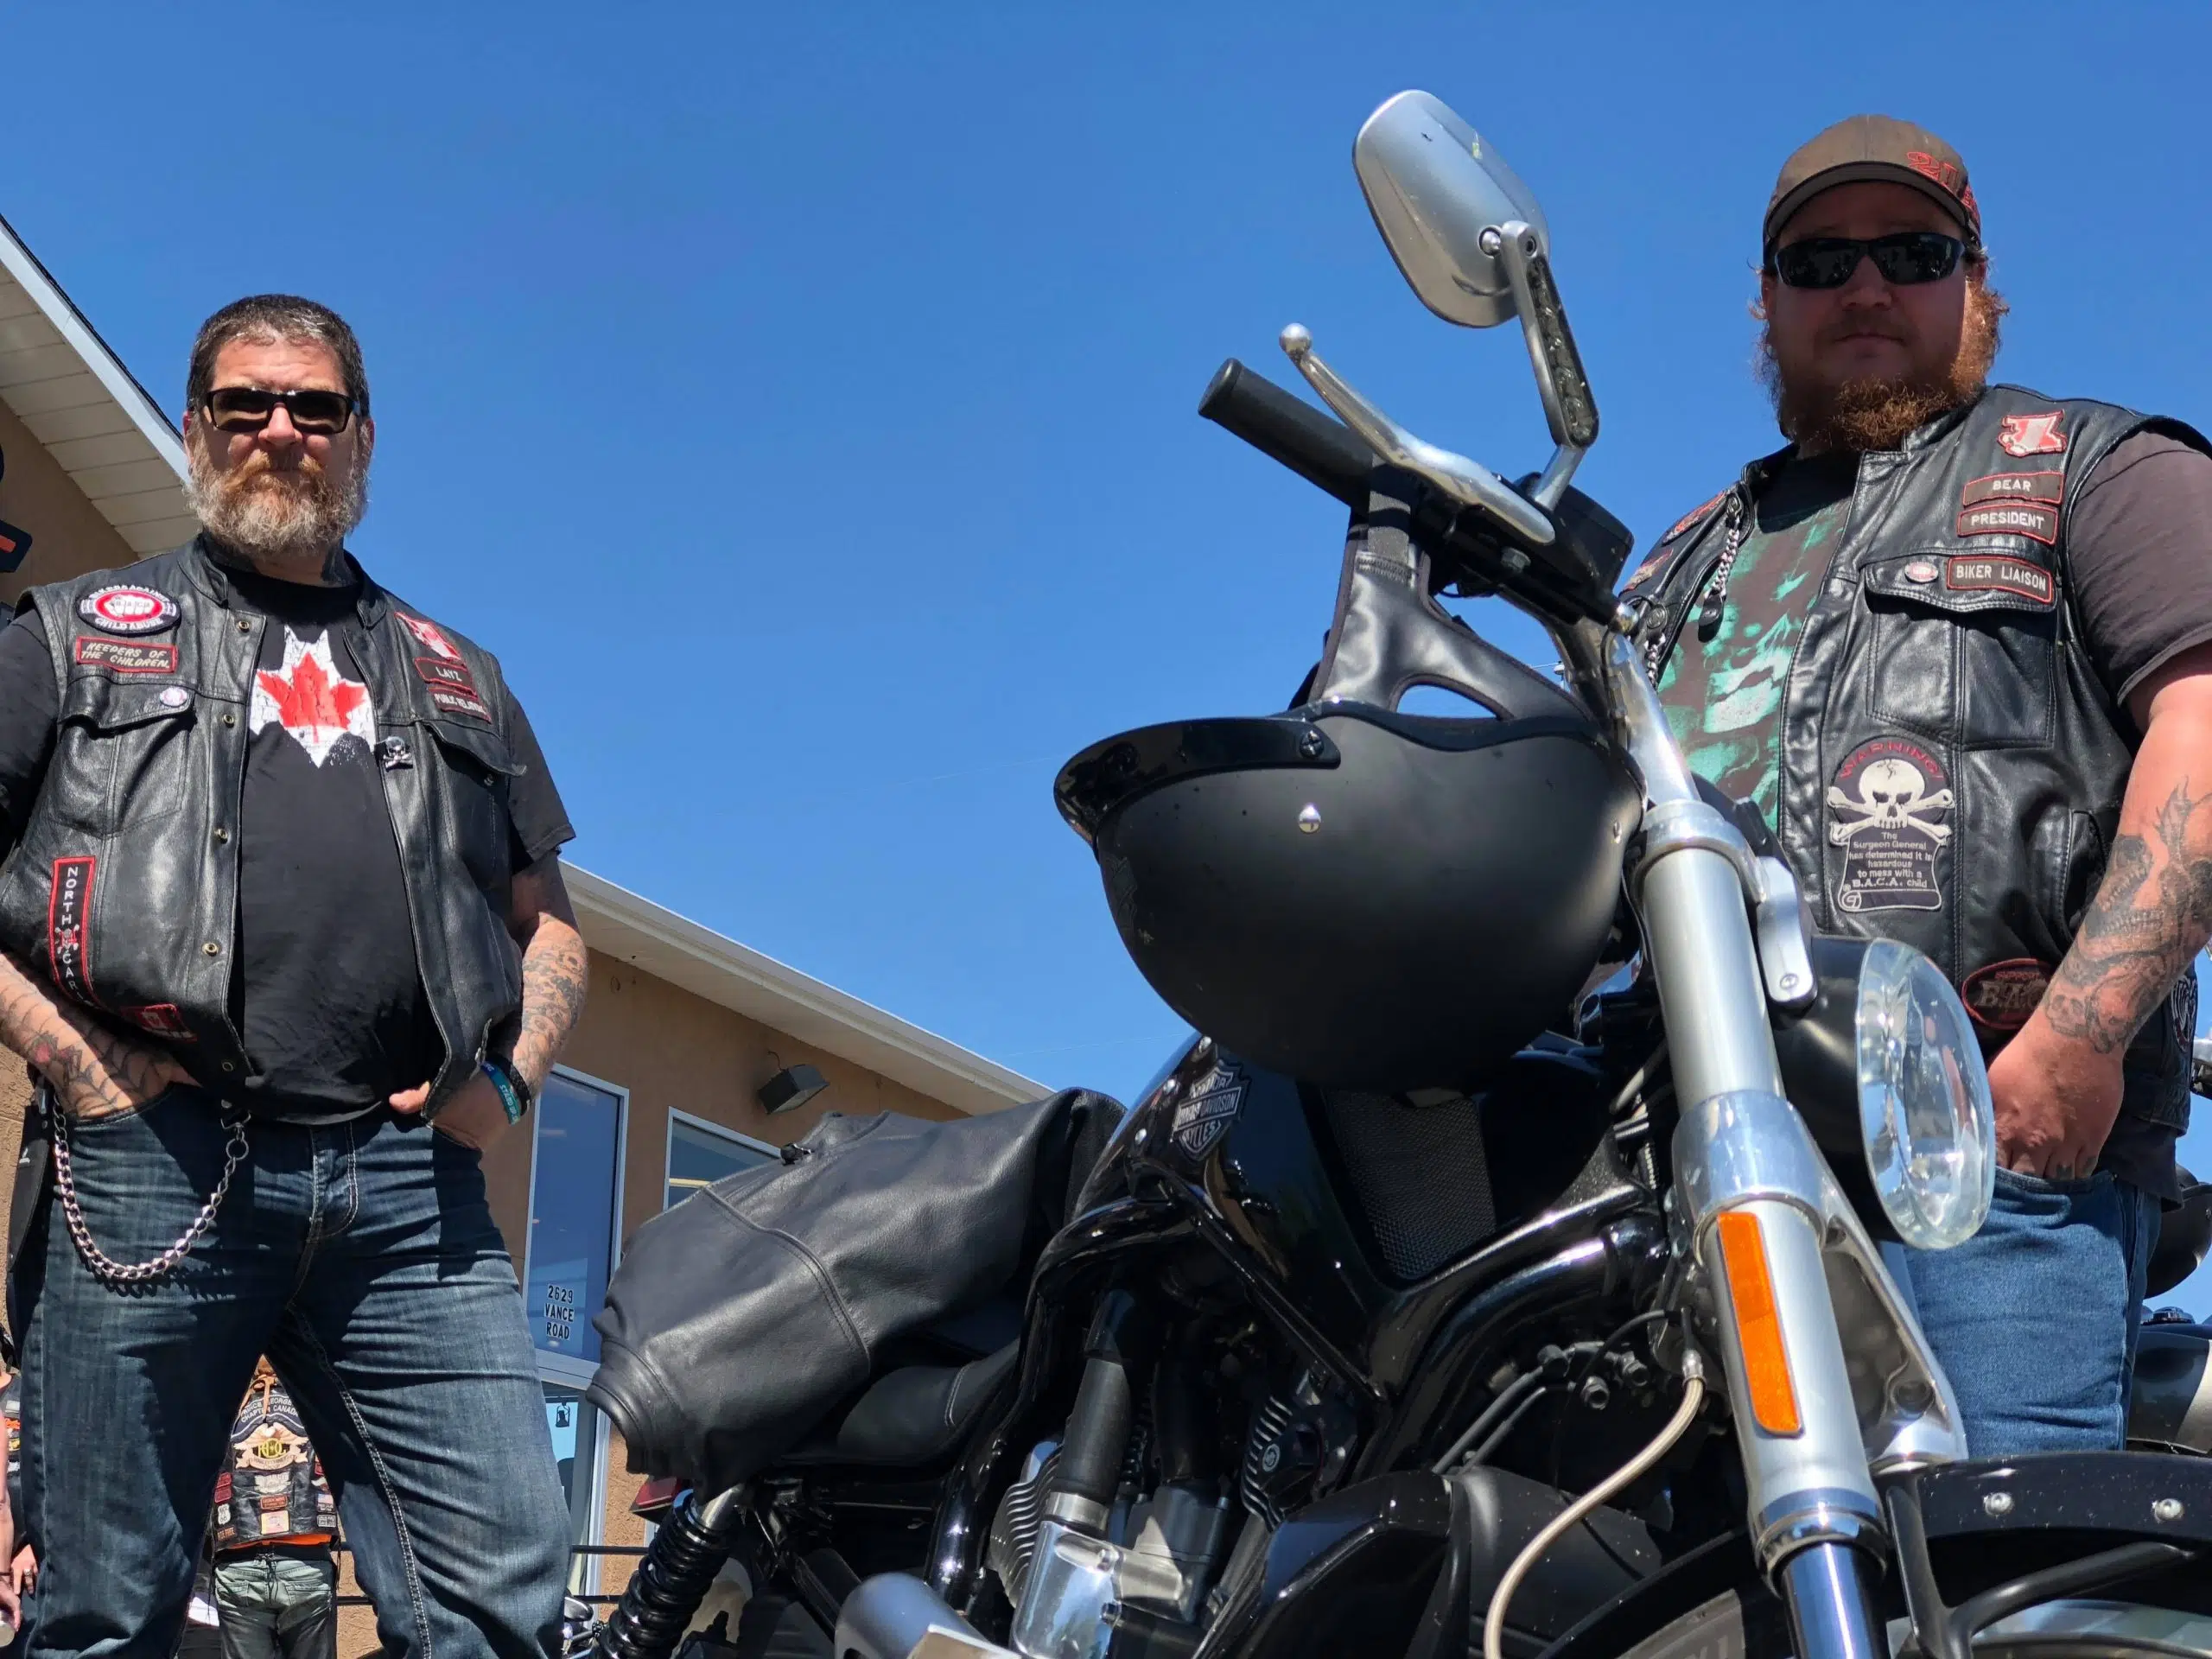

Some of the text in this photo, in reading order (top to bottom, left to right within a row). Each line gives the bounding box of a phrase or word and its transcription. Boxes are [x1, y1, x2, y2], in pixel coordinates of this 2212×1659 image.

[1993, 479, 2031, 492] BEAR
[1970, 512, 2045, 529] PRESIDENT
[1956, 565, 2046, 591] BIKER LIAISON
[81, 651, 104, 659] THE
[149, 650, 167, 659] OF
[1881, 831, 1897, 840] The
[1853, 841, 1927, 851] Surgeon General
[1849, 852, 1864, 861] has
[1866, 851, 1913, 860] determined
[1915, 852, 1923, 861] it
[1867, 860, 1913, 868] hazardous
[1857, 869, 1867, 878] to
[1869, 869, 1892, 878] mess
[1895, 868, 1914, 878] with
[1906, 879, 1928, 888] child
[61, 866, 79, 925] NORTH
[548, 1285, 574, 1304] 2629
[544, 1303, 575, 1322] VANCE
[546, 1322, 570, 1340] ROAD
